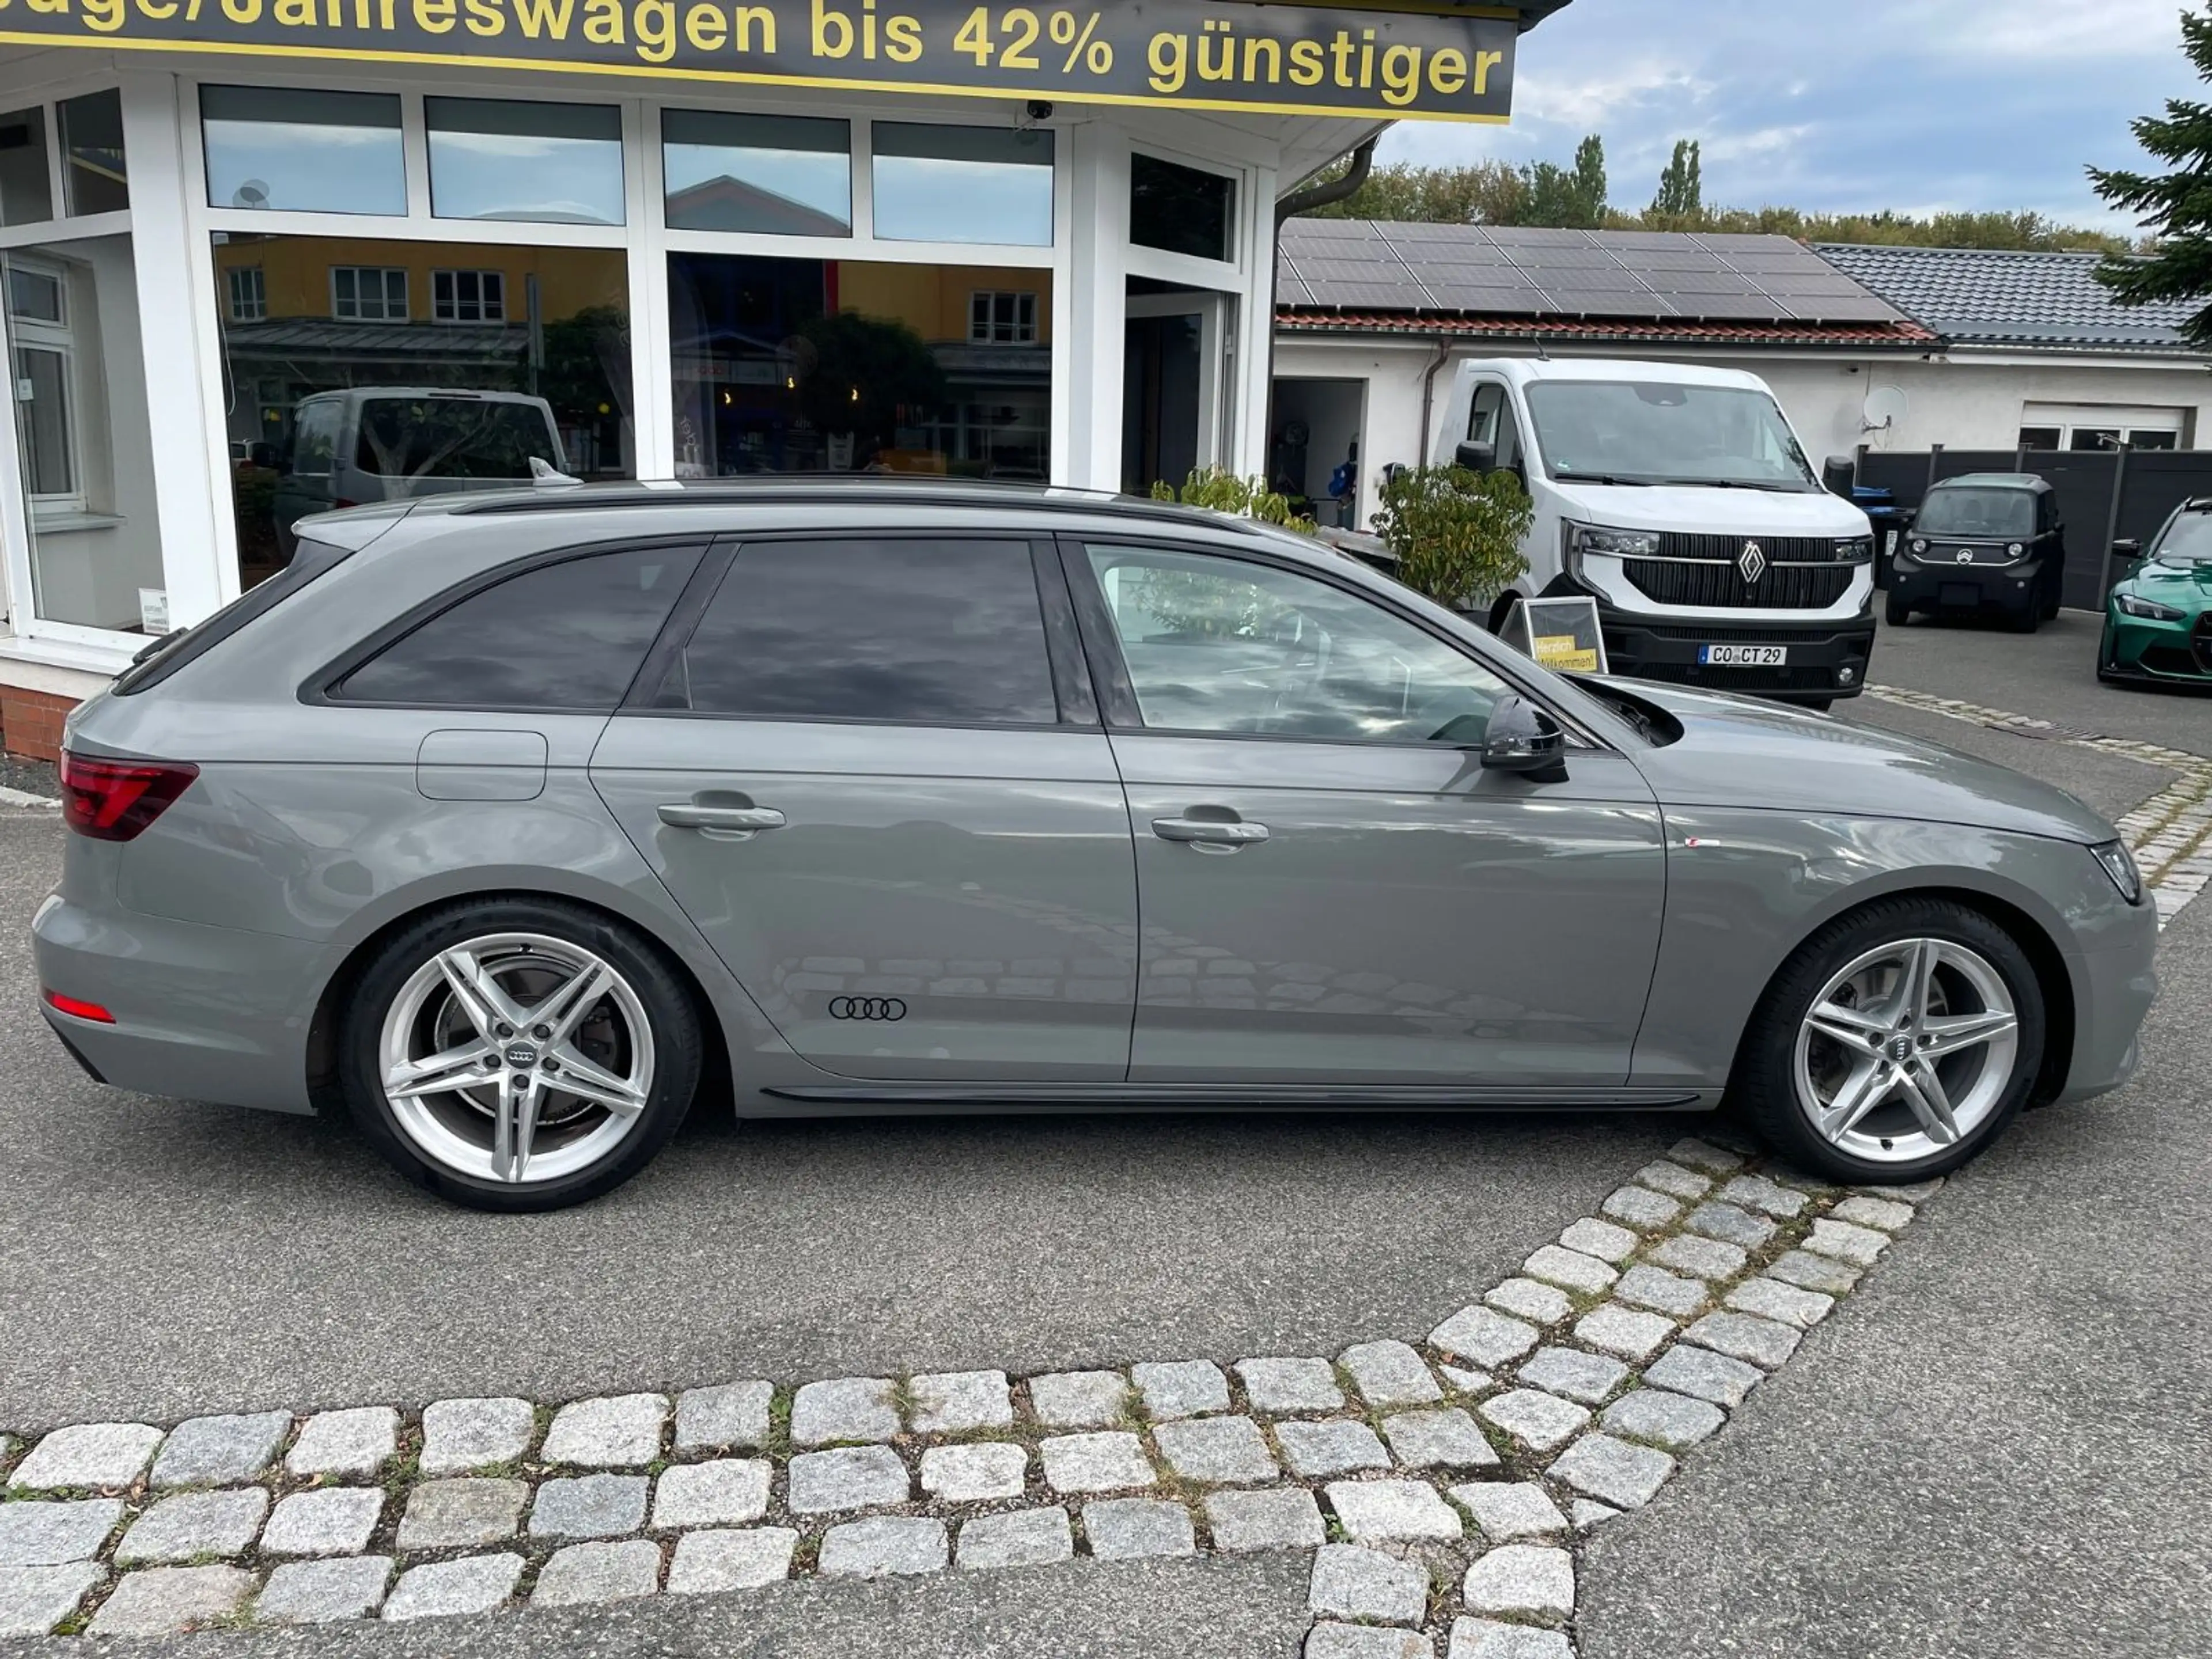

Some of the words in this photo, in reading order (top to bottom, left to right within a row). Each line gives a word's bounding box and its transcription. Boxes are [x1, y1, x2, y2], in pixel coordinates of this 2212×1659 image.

[812, 0, 923, 63] bis
[954, 7, 1111, 73] 42%
[1148, 21, 1500, 105] günstiger
[1713, 647, 1732, 662] CO
[1741, 648, 1760, 662] CT
[1763, 649, 1781, 663] 29
